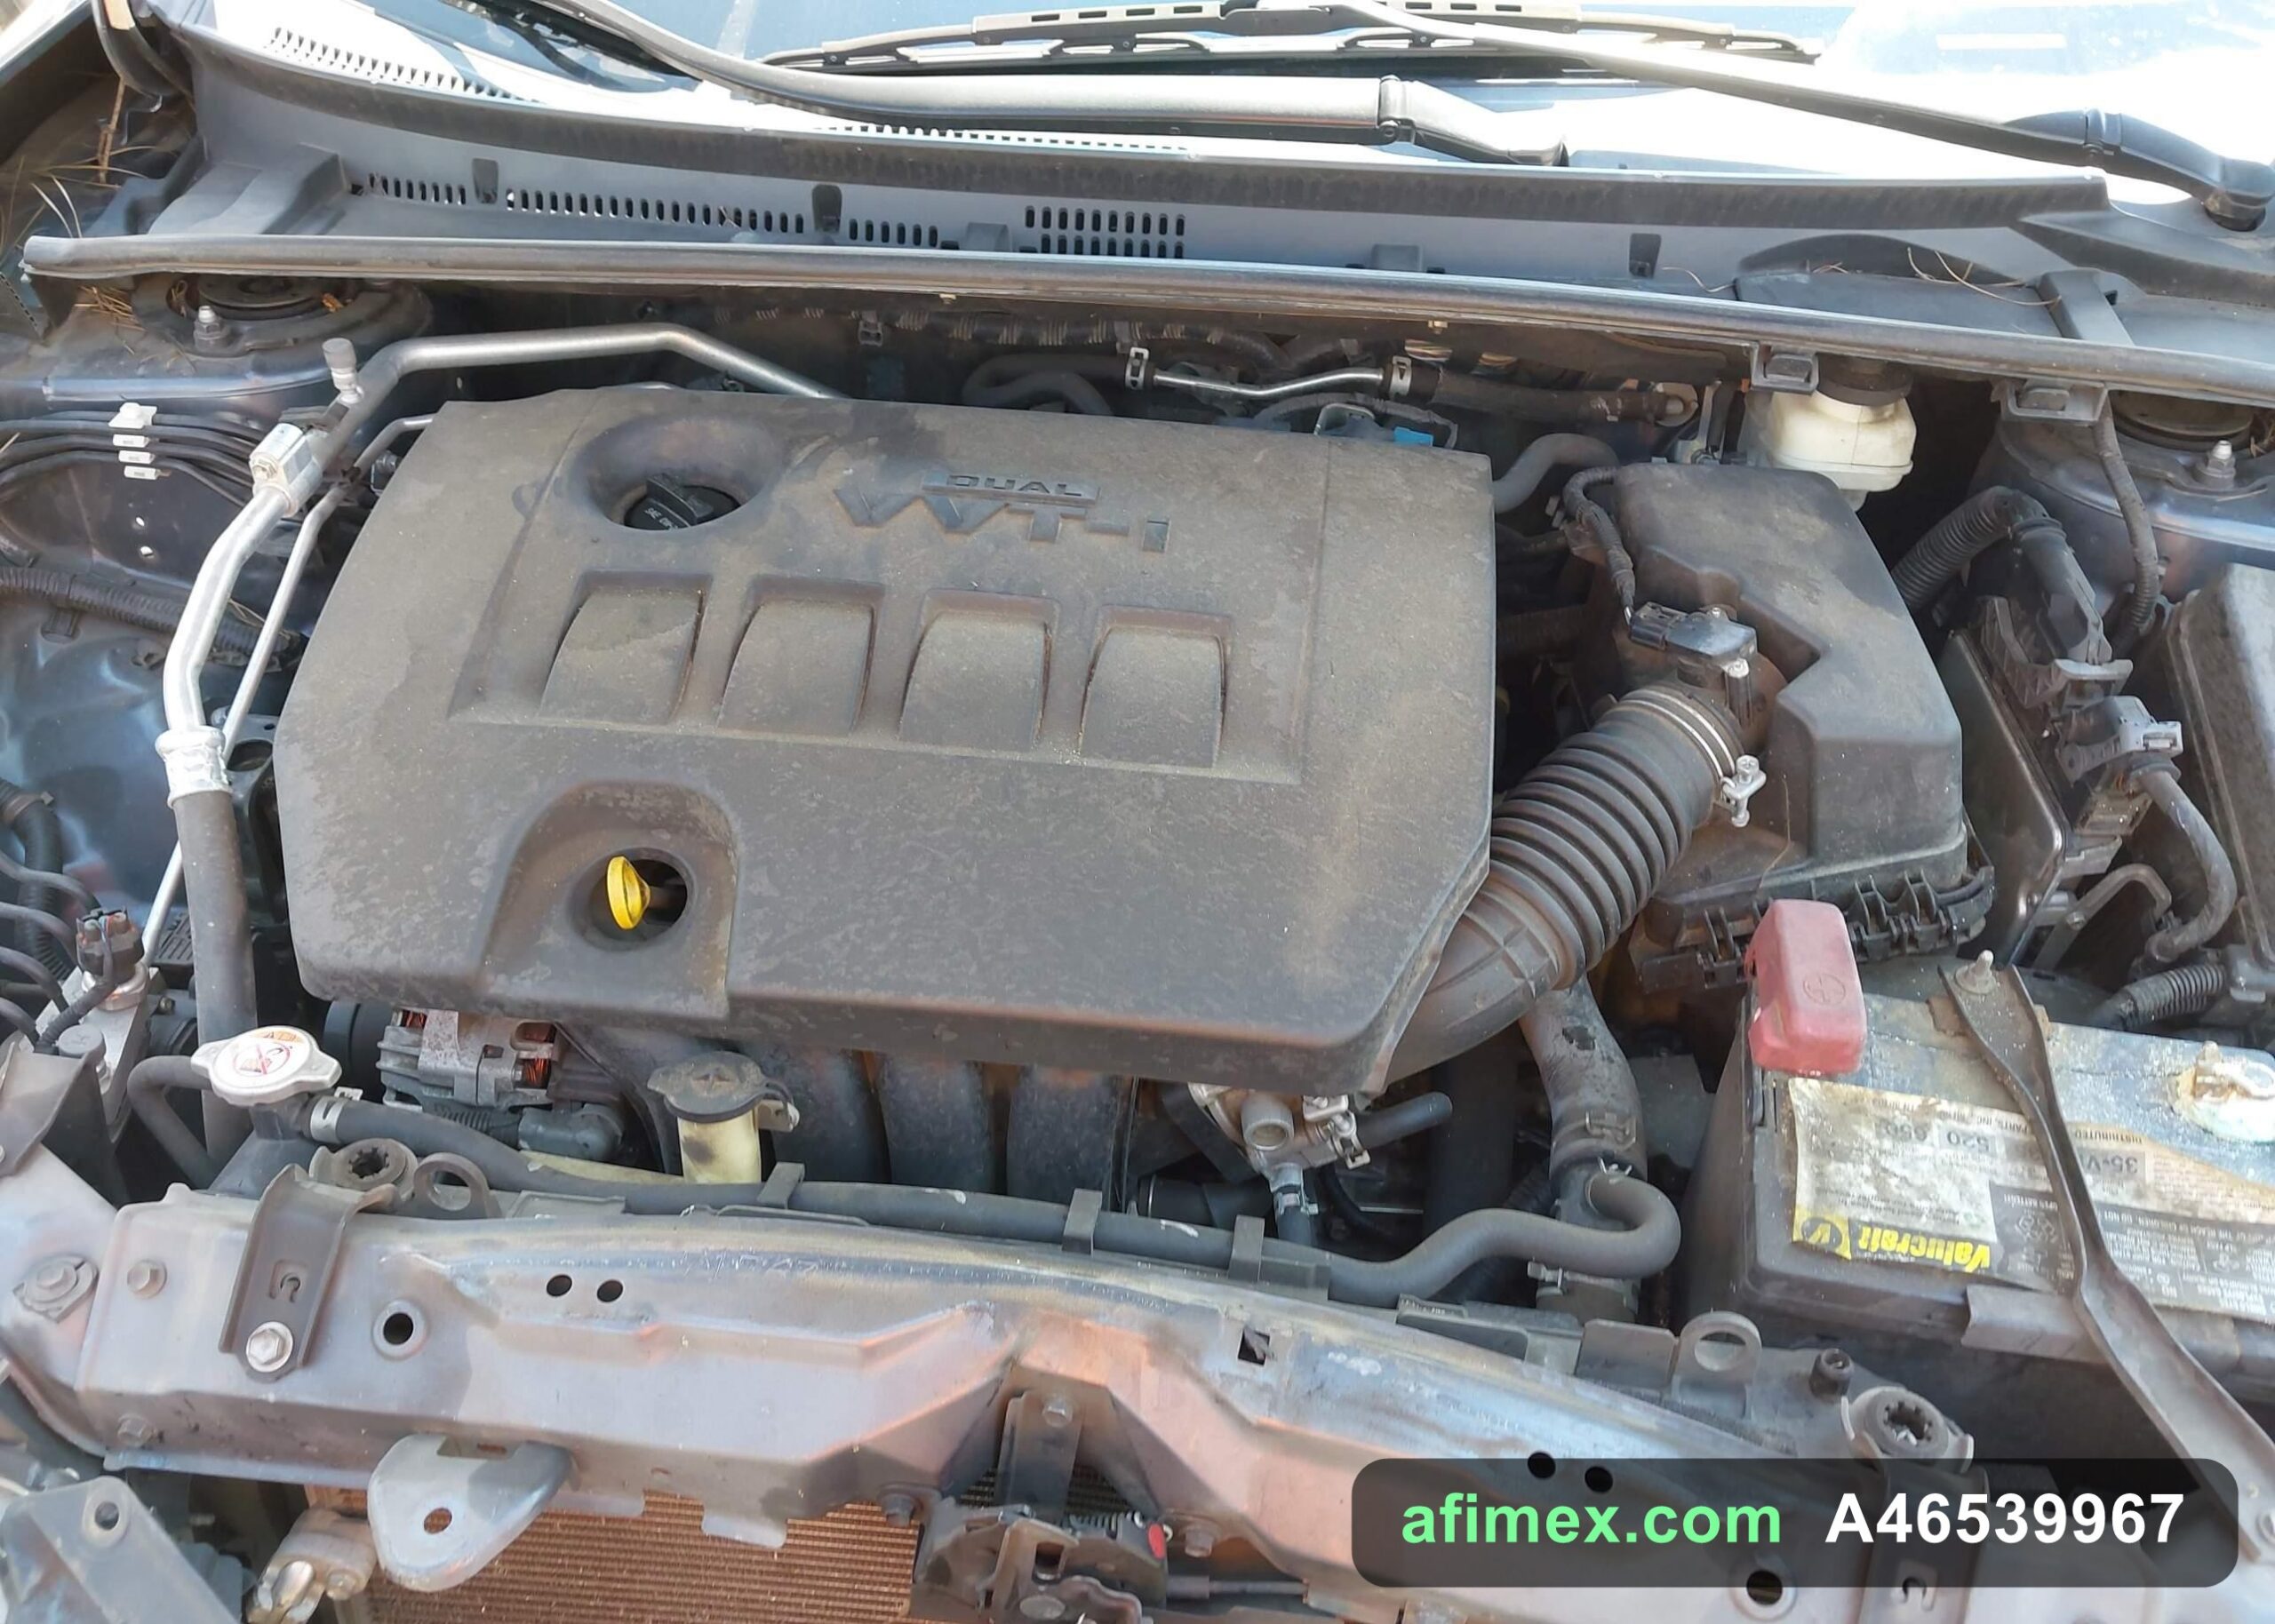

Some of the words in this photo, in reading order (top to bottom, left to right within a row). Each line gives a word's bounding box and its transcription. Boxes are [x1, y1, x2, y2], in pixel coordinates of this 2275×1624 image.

[946, 474, 1084, 498] DUAL
[1947, 1131, 1990, 1154] 520
[2079, 1154, 2138, 1174] 35-V
[1858, 1226, 1991, 1273] Valucraft
